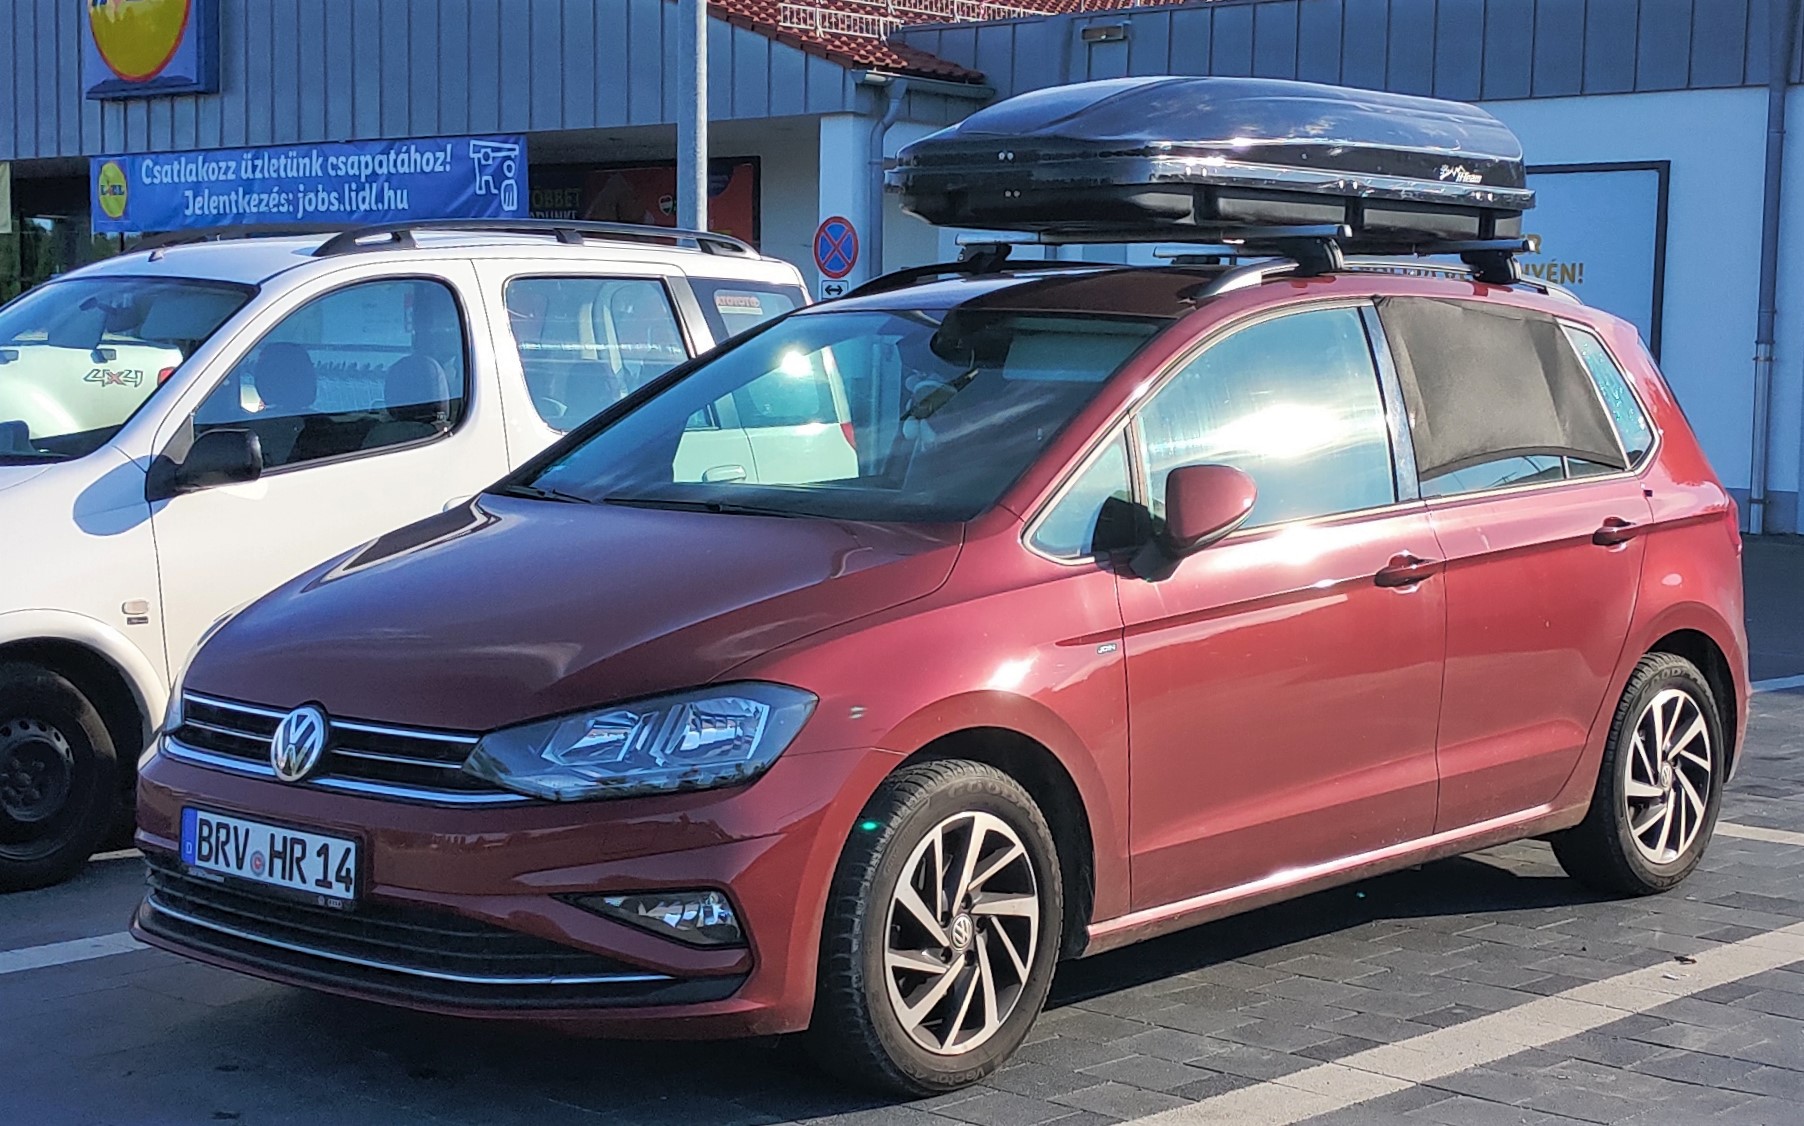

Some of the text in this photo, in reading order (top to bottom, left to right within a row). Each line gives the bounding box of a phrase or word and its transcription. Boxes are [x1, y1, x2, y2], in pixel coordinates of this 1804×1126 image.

[141, 143, 453, 185] Csatlakozz üzletünk csapatához!
[184, 181, 410, 219] Jelentkezés: jobs.lidl.hu
[196, 817, 354, 893] BRV HR 14
